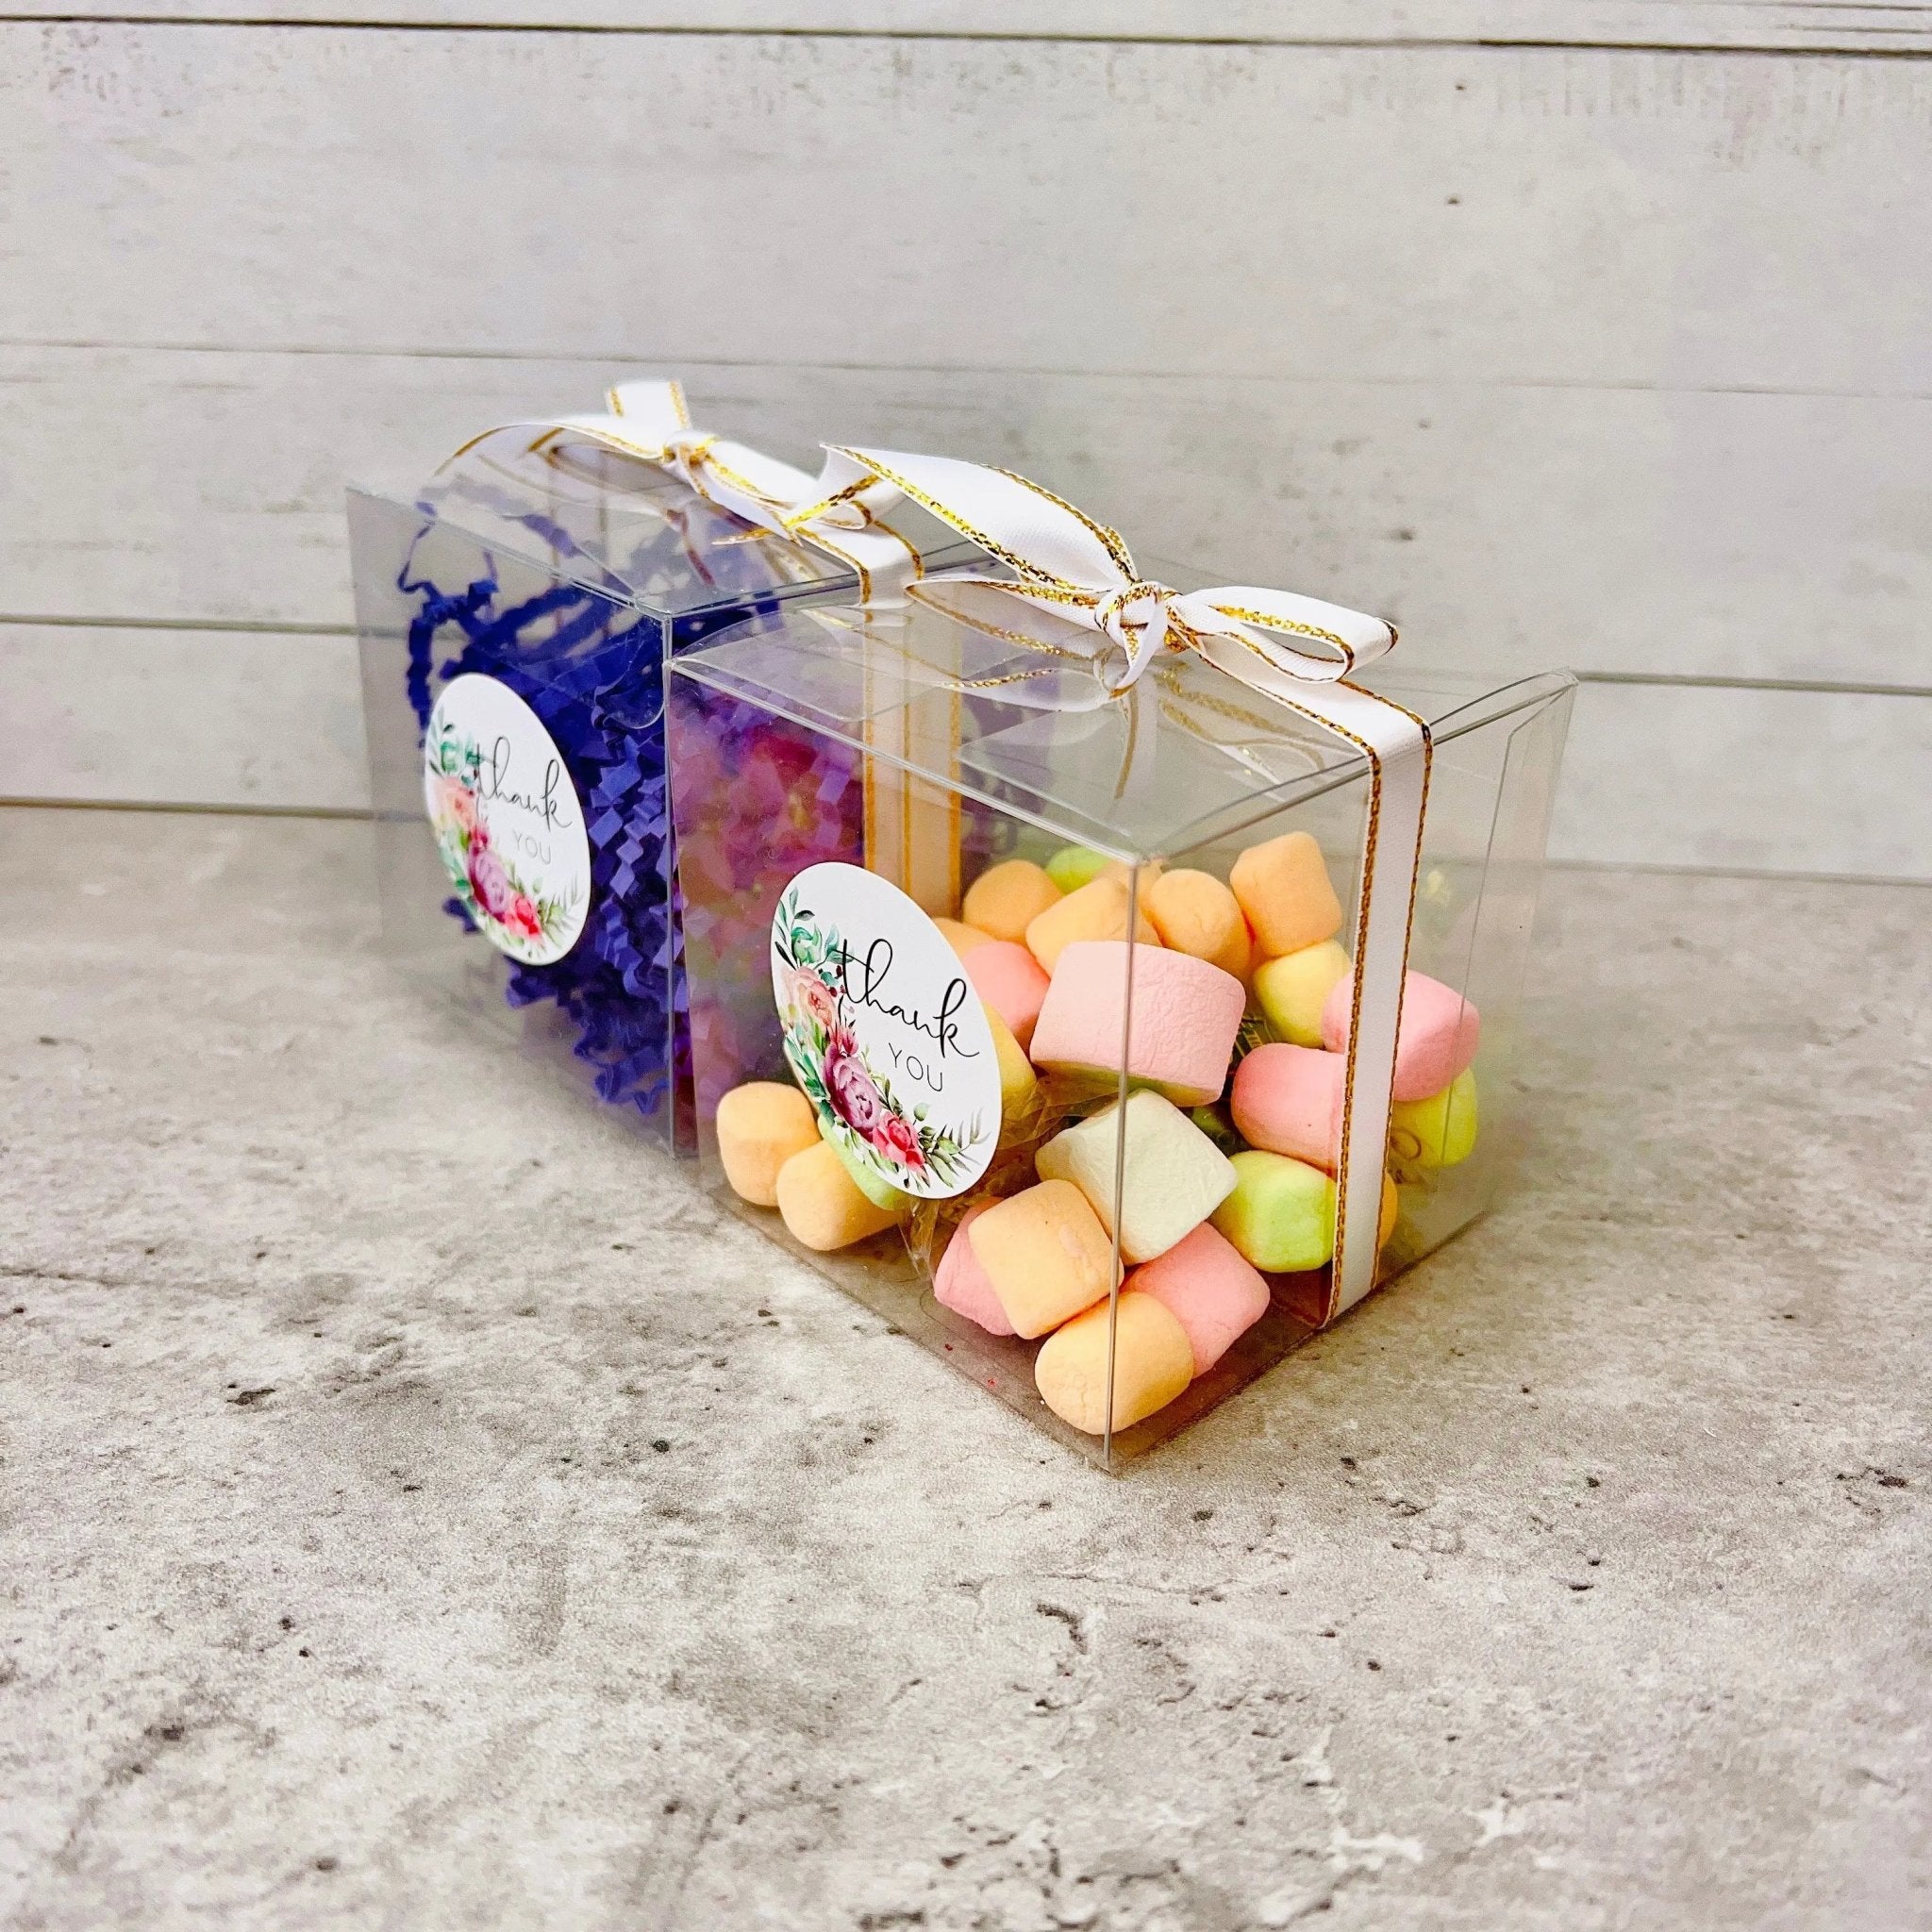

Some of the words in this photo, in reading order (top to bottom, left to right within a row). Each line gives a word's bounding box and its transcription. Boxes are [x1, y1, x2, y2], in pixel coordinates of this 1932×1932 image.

[472, 736, 572, 832] thank
[512, 827, 552, 864] YOU
[833, 939, 980, 1058] thank
[888, 1042, 943, 1092] YOU
